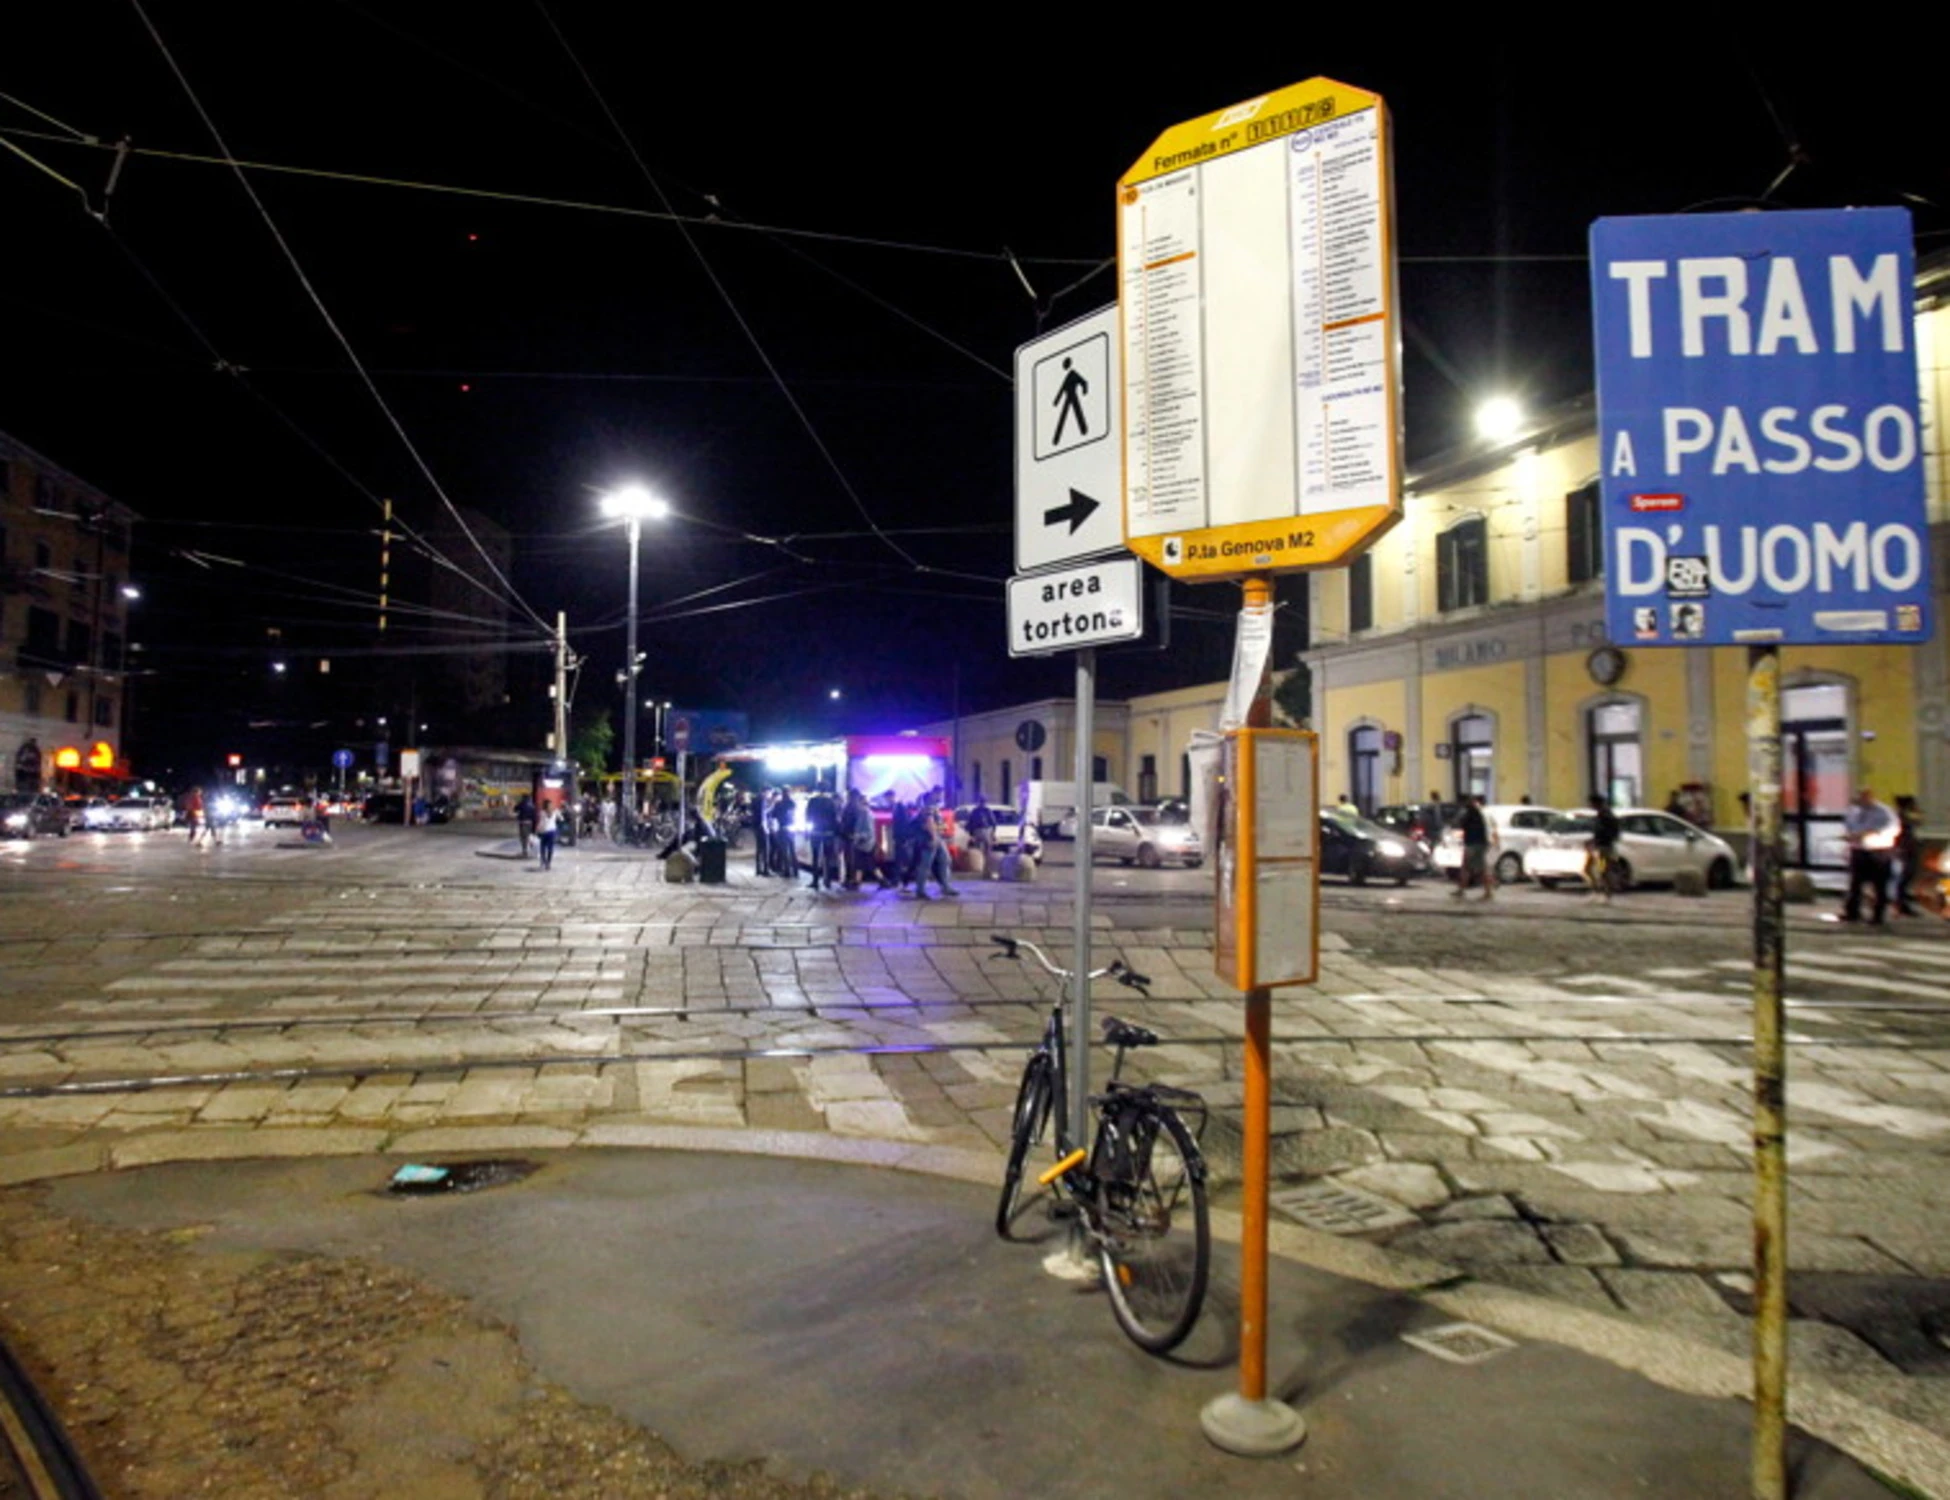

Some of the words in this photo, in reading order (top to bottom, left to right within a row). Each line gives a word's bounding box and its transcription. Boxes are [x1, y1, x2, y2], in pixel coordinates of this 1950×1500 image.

[1153, 141, 1218, 171] Fermata
[1609, 253, 1904, 358] TRAM
[1612, 430, 1637, 476] A
[1663, 404, 1917, 476] PASSO
[1187, 545, 1217, 561] P.ta
[1221, 538, 1285, 557] Genova
[1288, 531, 1316, 549] M2
[1615, 522, 1922, 597] D'UOMO
[1042, 575, 1101, 603] area
